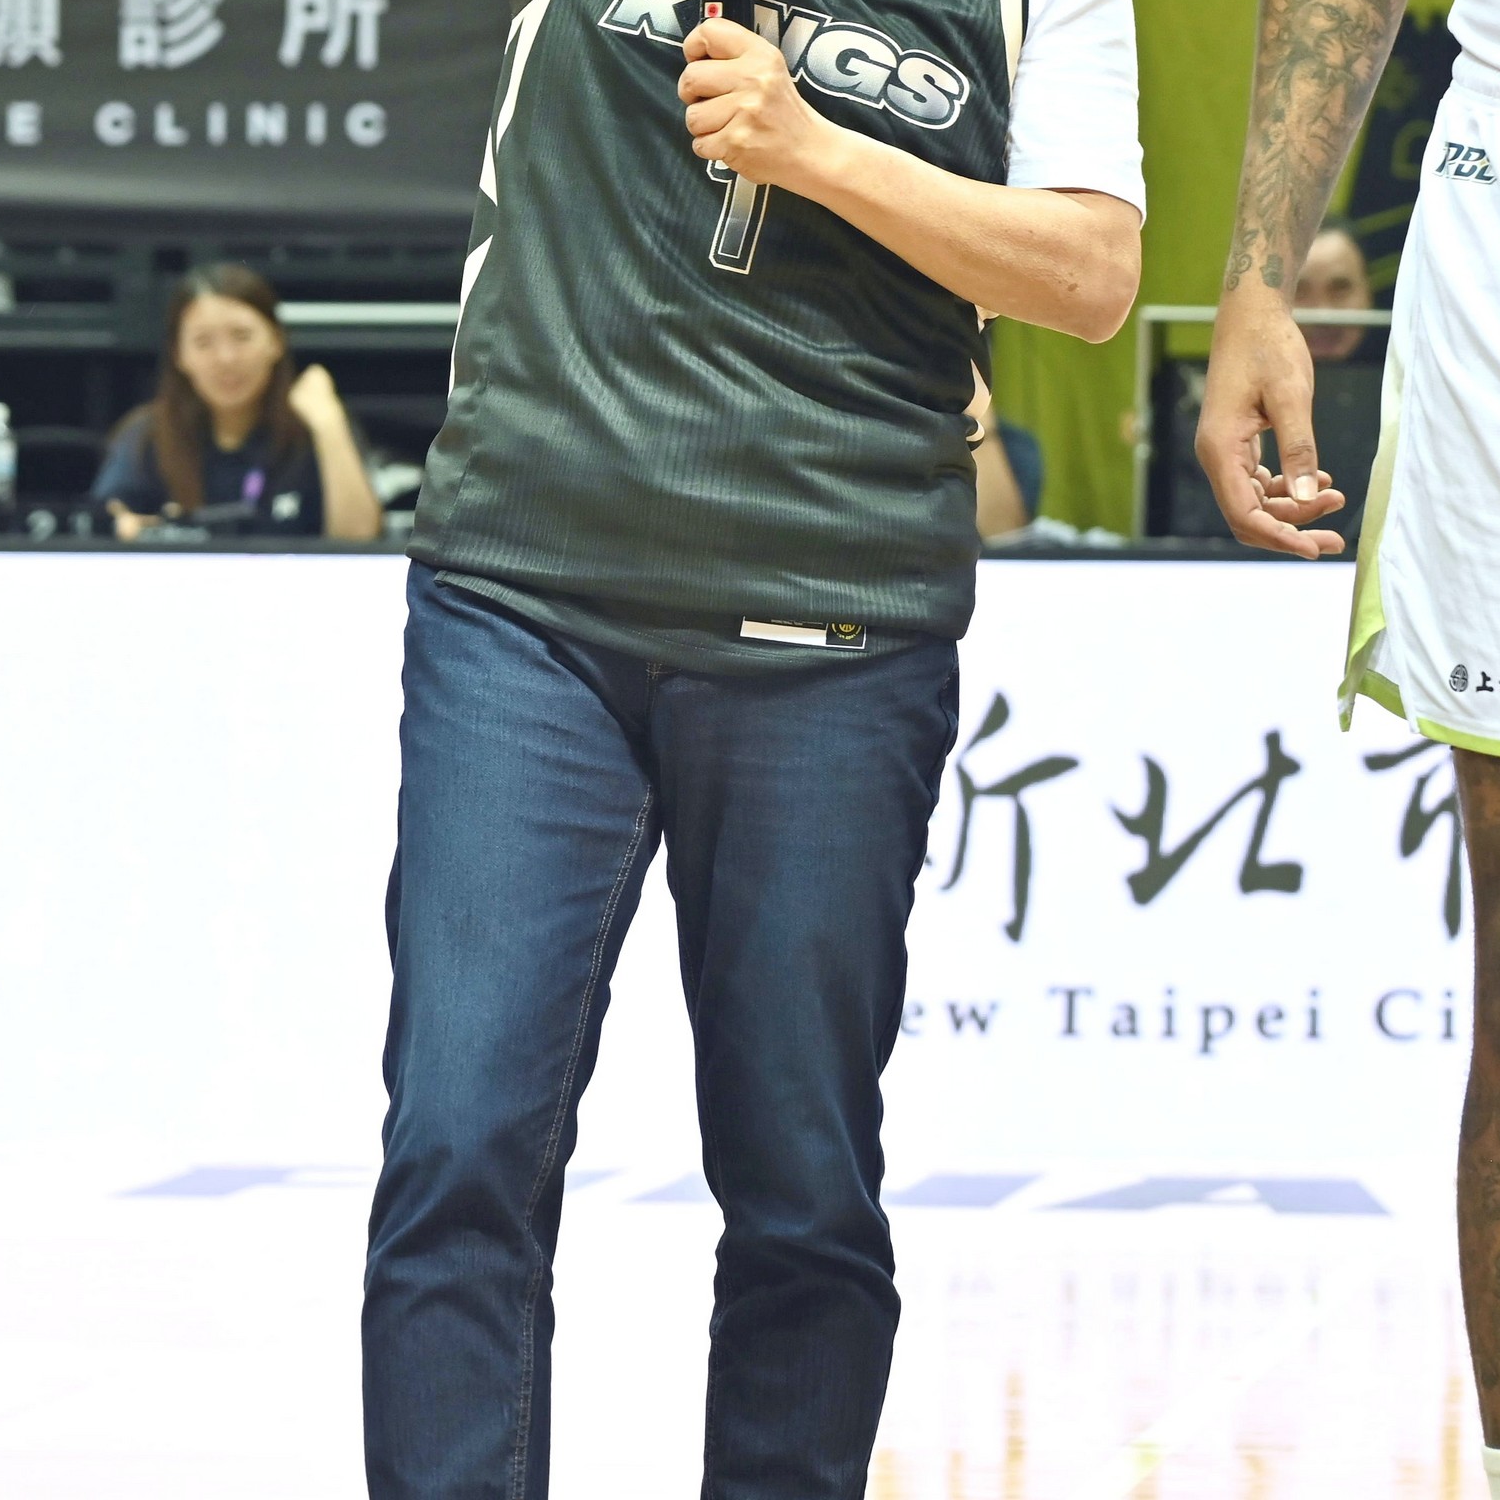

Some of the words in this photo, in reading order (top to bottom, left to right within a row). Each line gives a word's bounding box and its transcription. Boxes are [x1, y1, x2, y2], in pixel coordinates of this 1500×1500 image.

[95, 101, 389, 148] CLINIC
[900, 998, 1000, 1038] ew
[1048, 986, 1323, 1055] Taipei
